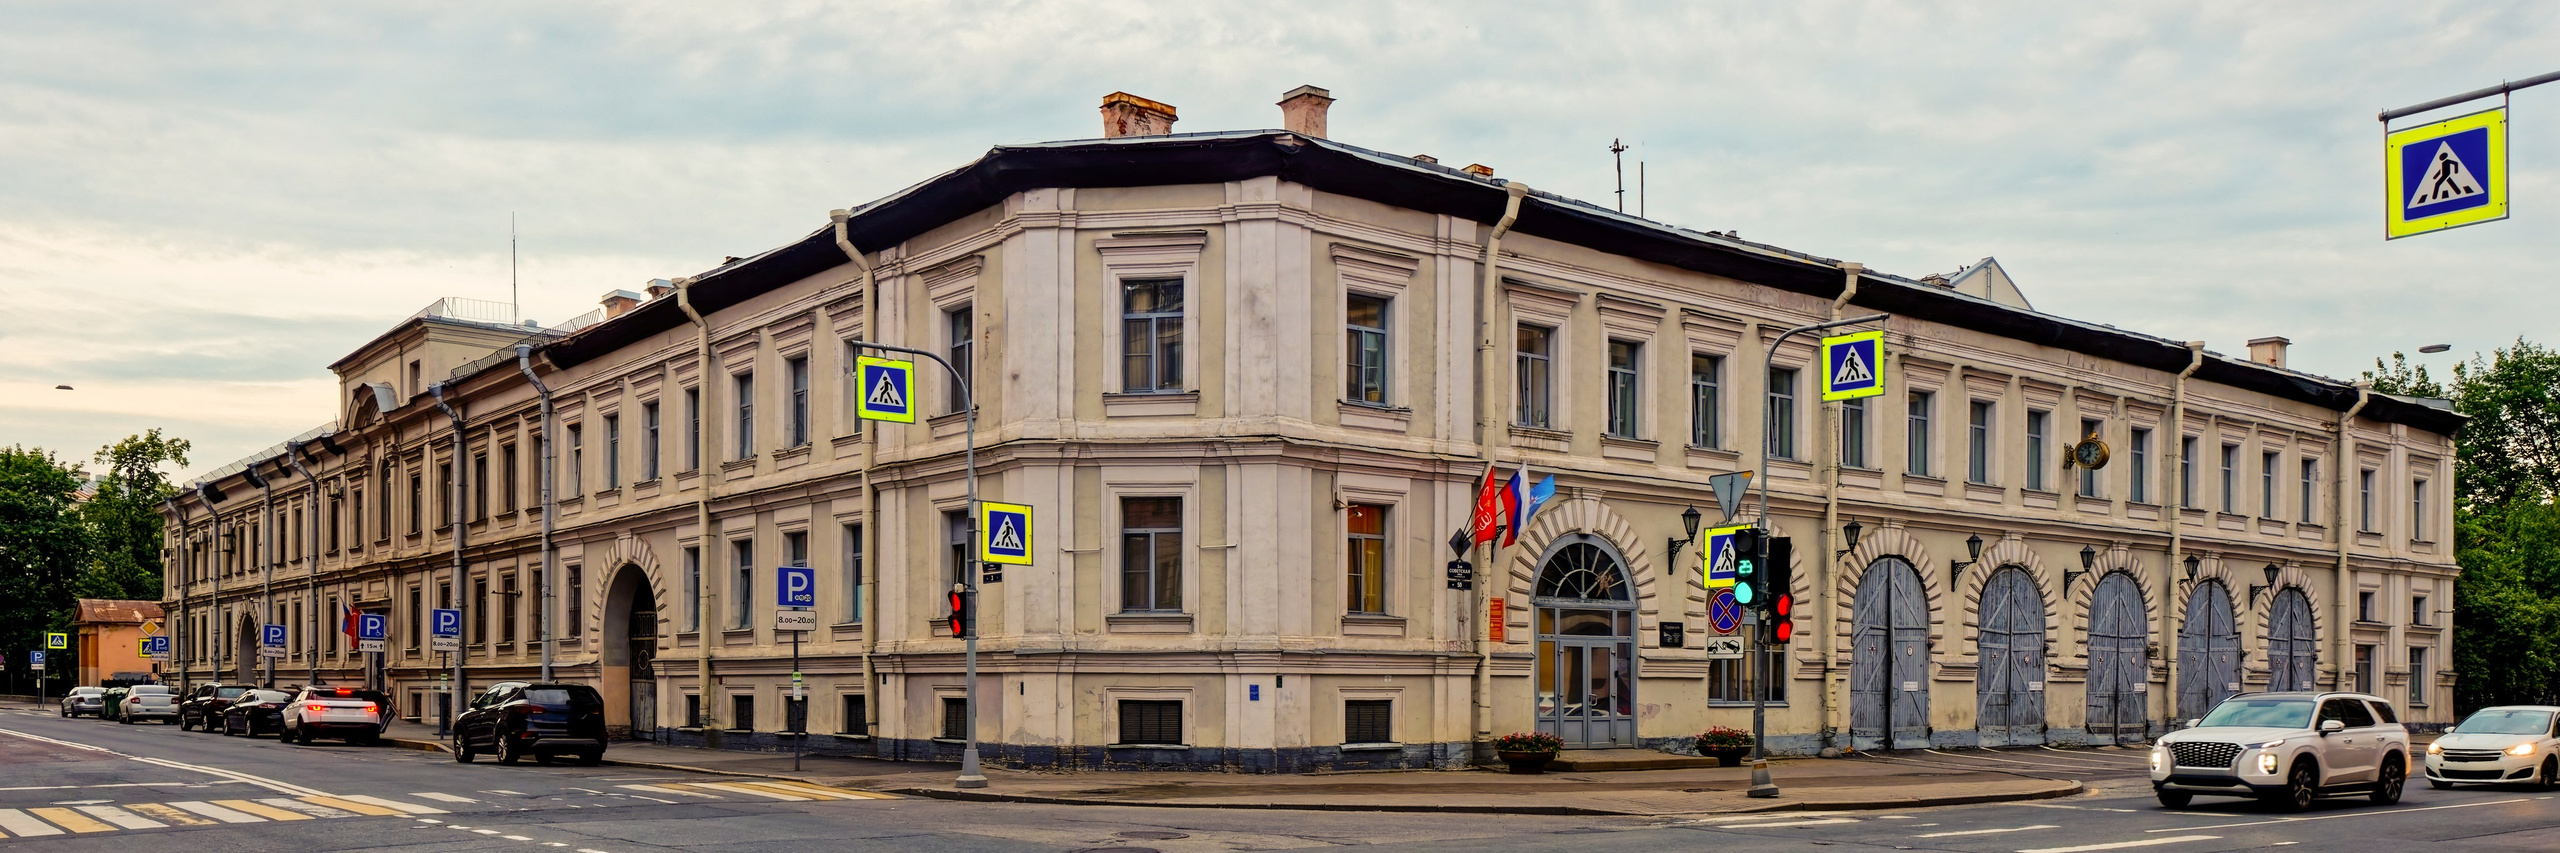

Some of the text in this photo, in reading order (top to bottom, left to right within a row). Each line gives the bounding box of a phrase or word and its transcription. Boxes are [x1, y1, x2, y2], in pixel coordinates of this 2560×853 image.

[788, 571, 808, 602] P
[366, 617, 380, 636] P
[440, 611, 456, 632] P
[156, 637, 166, 650] P
[269, 627, 282, 643] P
